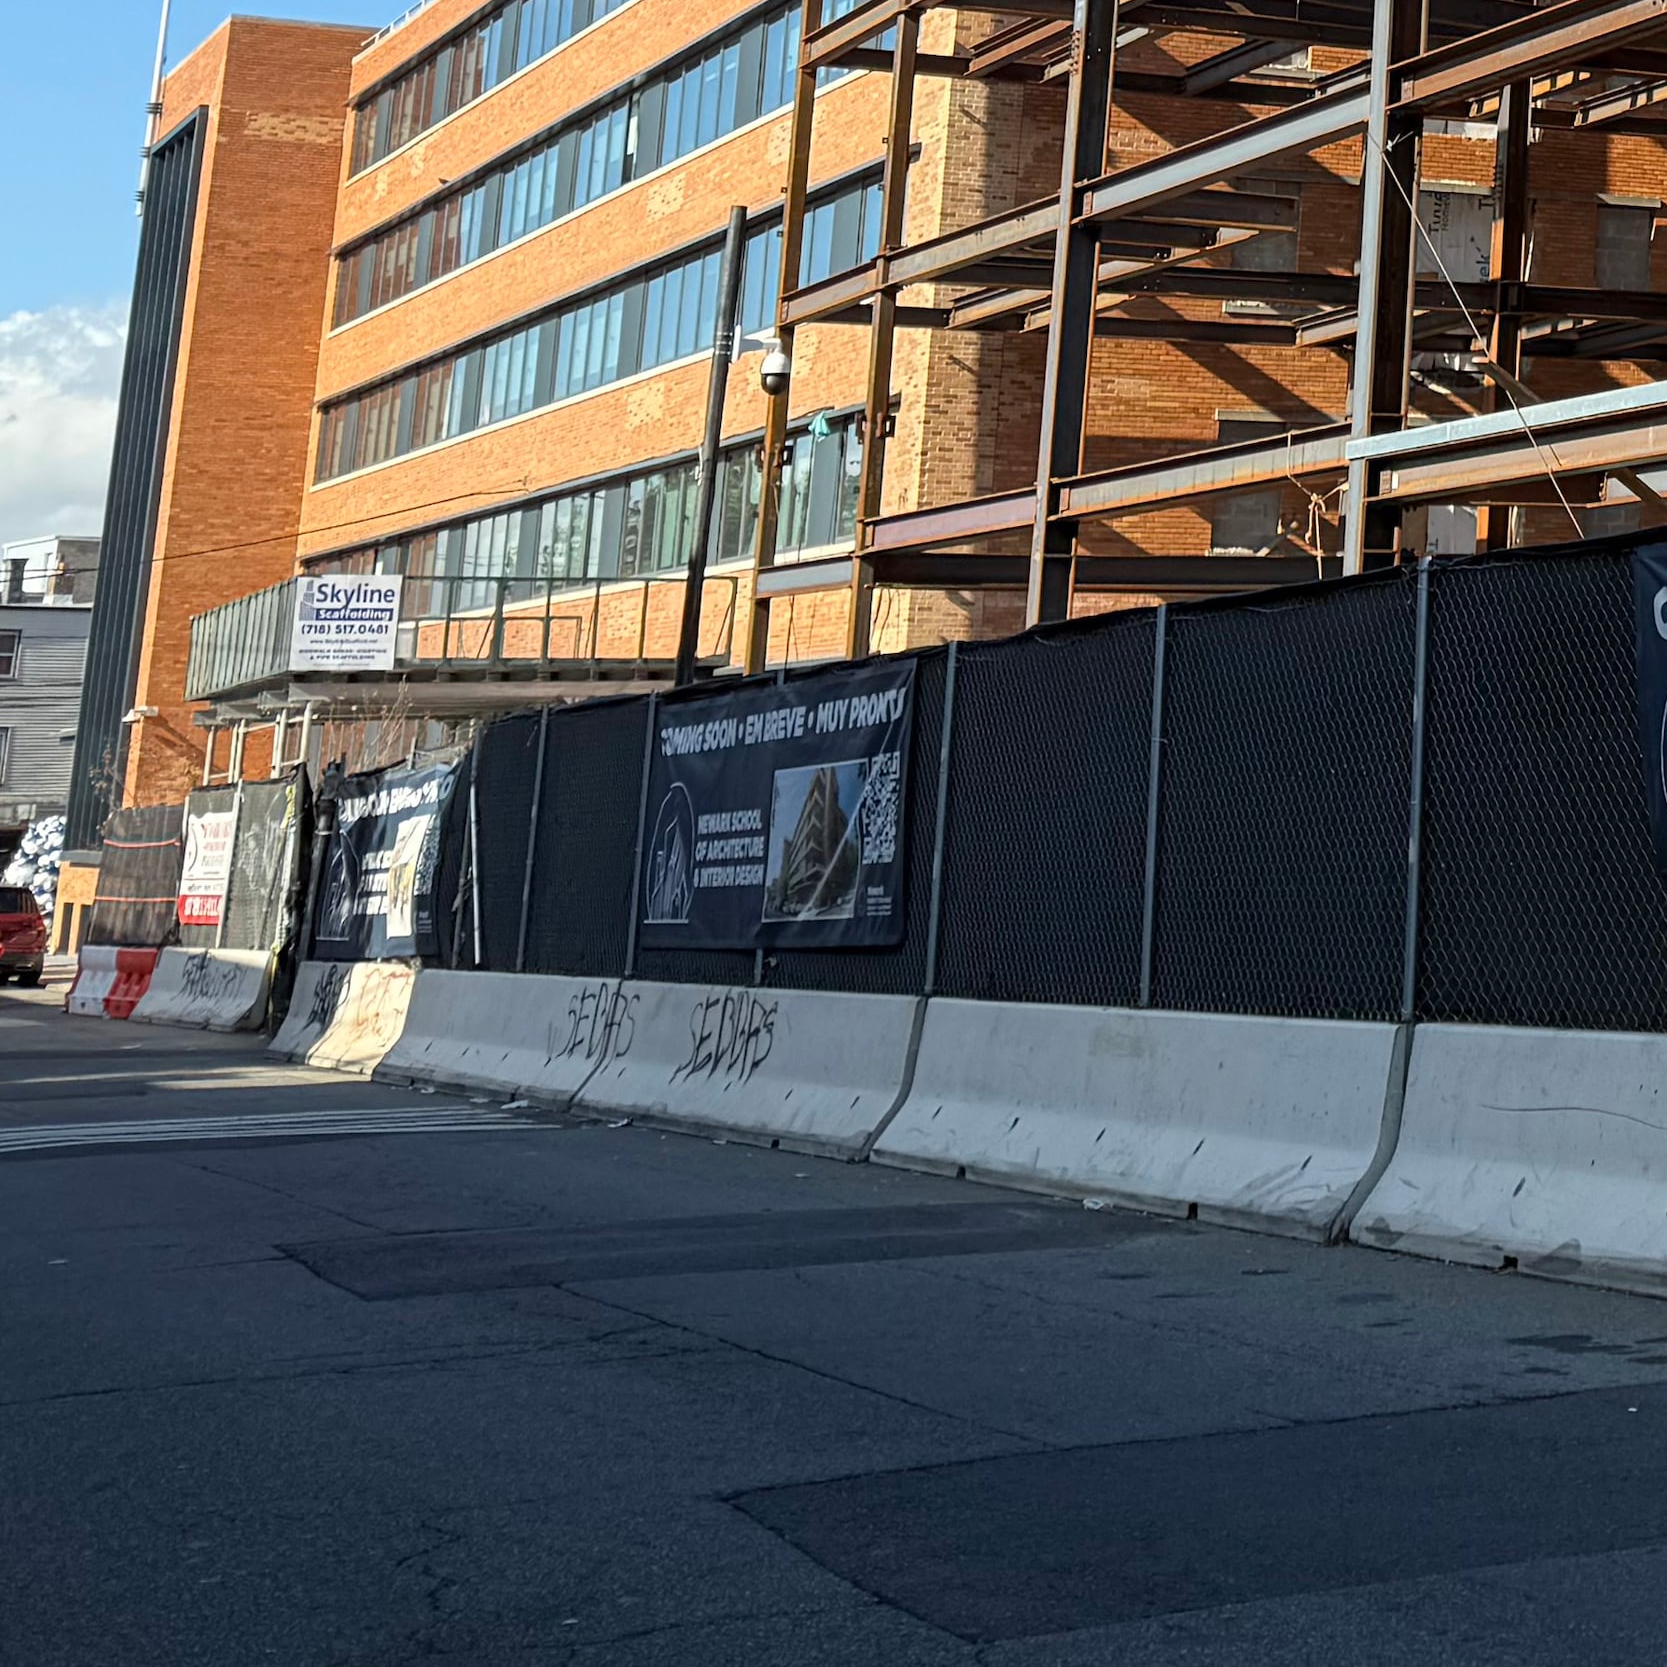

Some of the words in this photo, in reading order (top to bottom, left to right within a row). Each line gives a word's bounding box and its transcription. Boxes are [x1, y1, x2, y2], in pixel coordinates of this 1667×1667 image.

[316, 583, 395, 610] Skyline
[319, 609, 390, 621] Scaffolding
[301, 624, 331, 635] (718)
[335, 624, 389, 635] 517.0481
[816, 699, 849, 734] MUY
